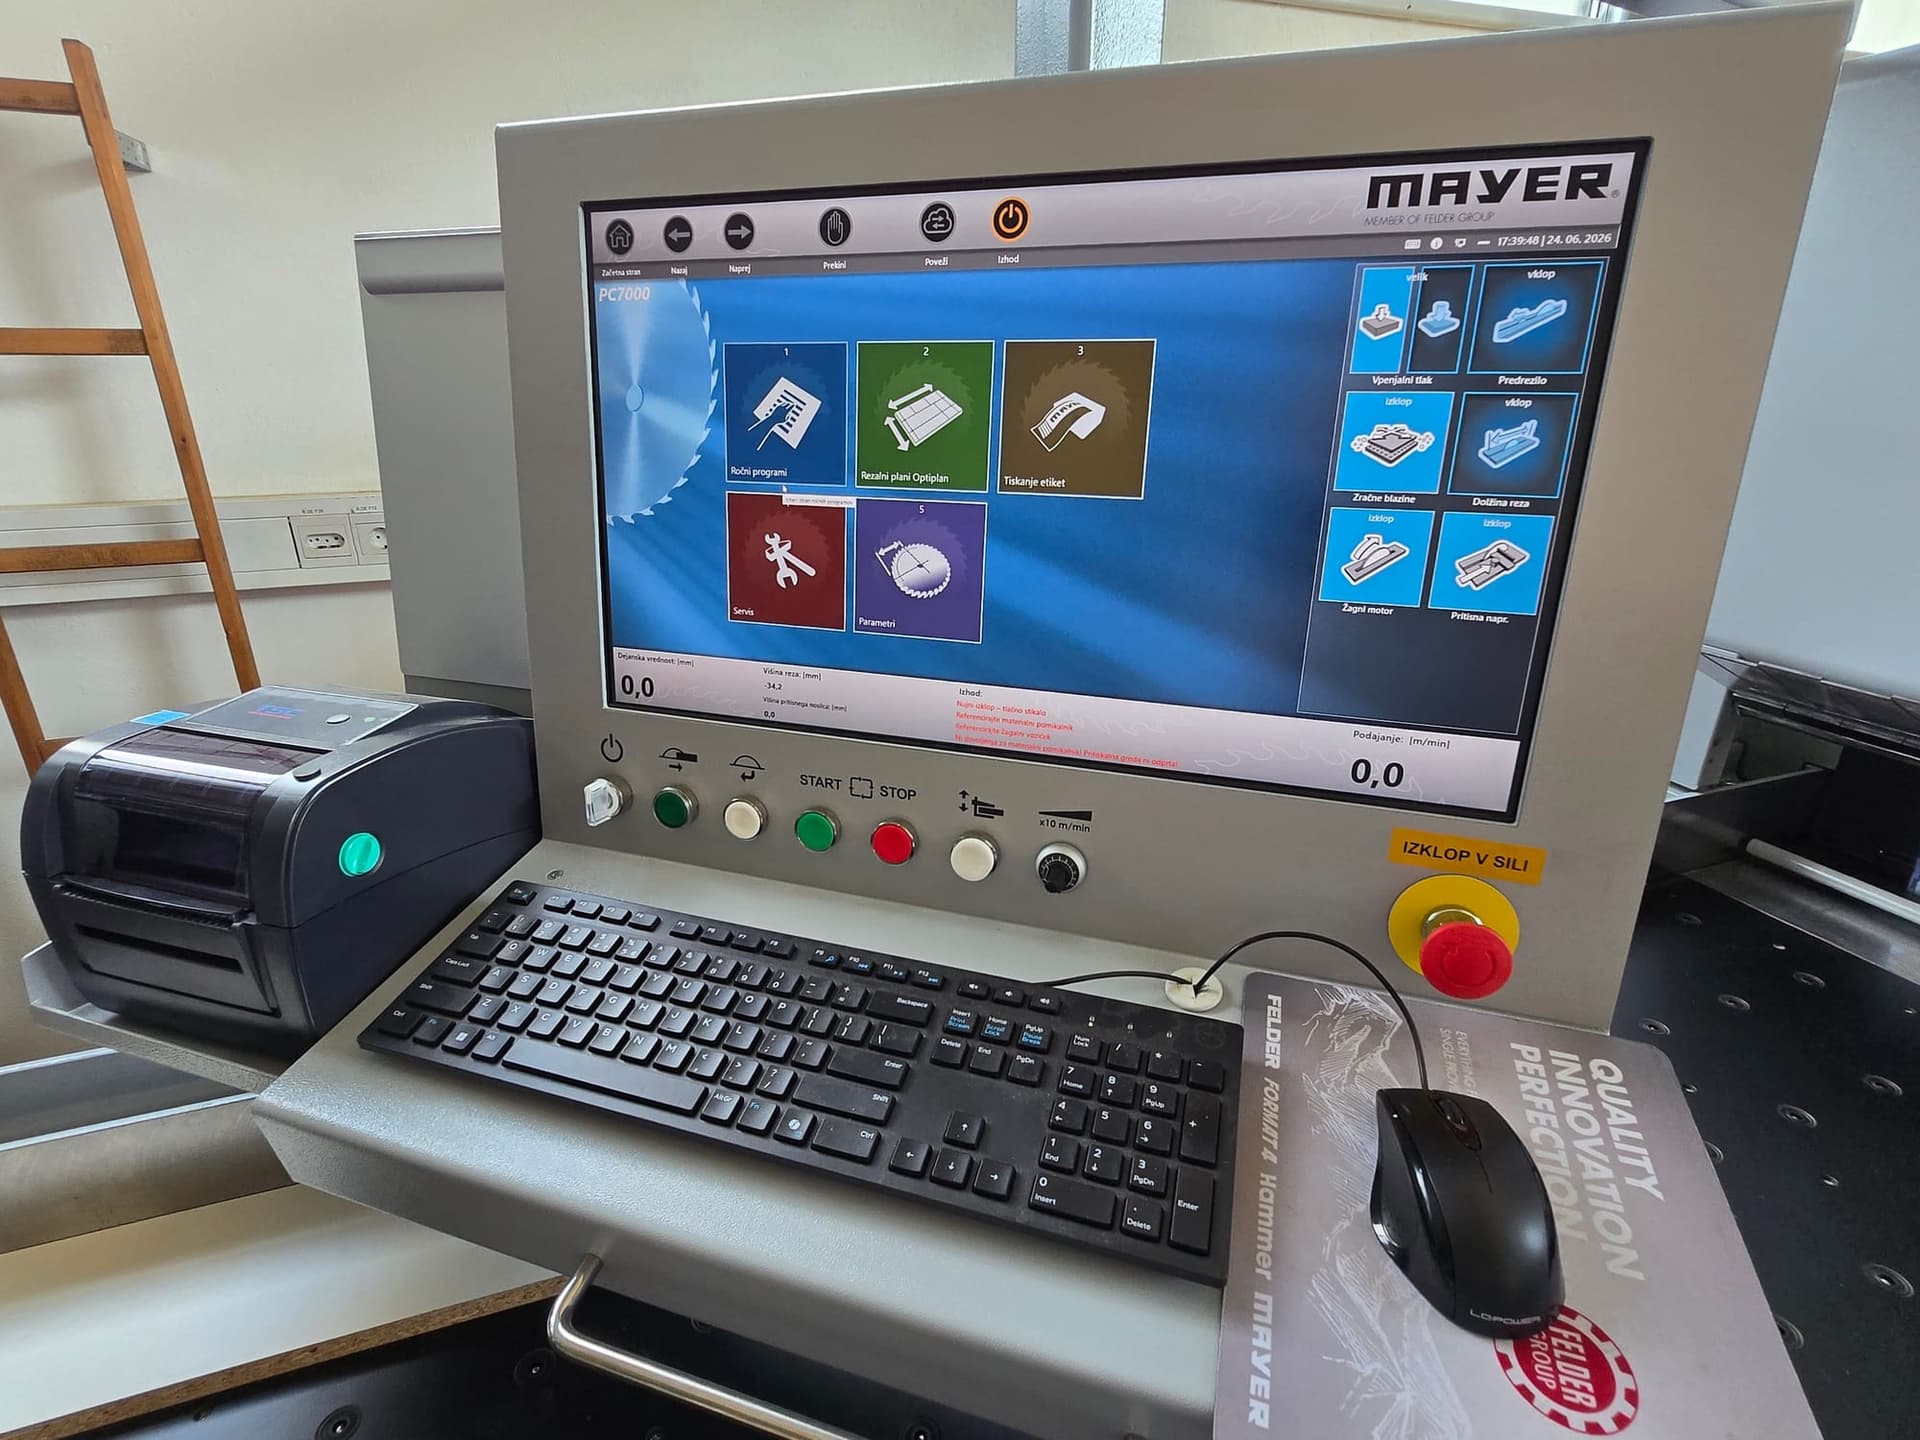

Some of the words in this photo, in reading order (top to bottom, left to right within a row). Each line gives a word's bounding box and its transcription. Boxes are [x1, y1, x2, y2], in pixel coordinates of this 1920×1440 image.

[1366, 163, 1611, 209] MAYER
[1364, 214, 1404, 226] MEMBER
[1407, 214, 1422, 225] OF
[1424, 213, 1455, 224] FELDER
[1457, 212, 1495, 223] GROUP
[1498, 236, 1539, 247] 17:39:48
[1584, 233, 1612, 244] 2026
[823, 260, 847, 270] Prekini
[997, 254, 1020, 265] Izhod
[625, 268, 641, 277] stran
[671, 266, 688, 276] Nazaj
[728, 263, 751, 275] Naprej
[1527, 269, 1556, 280] vklop
[1406, 271, 1429, 282] velik
[599, 286, 650, 302] PC7000
[1372, 375, 1414, 386] Vpenjalni
[1415, 375, 1433, 385] tlak
[1498, 375, 1548, 385] Predrezilo
[1385, 397, 1412, 408] izklop
[1505, 398, 1532, 409] vklop
[730, 467, 751, 477] Ročni
[751, 468, 787, 479] programi
[861, 470, 888, 481] Rezalni
[889, 472, 911, 483] plani
[912, 472, 950, 485] Optiplan
[1003, 476, 1039, 489] Tiskanje
[1040, 478, 1066, 488] etiket
[1352, 493, 1382, 503] Zračne
[1384, 494, 1416, 504] blazine
[1472, 498, 1504, 508] Dolžina
[1505, 499, 1530, 508] reza
[1368, 514, 1394, 524] izklop
[1483, 519, 1511, 529] izklop
[733, 606, 754, 616] Servis
[1342, 603, 1367, 616] Žagni
[1369, 606, 1394, 616] motor
[858, 617, 896, 629] Parametri
[1451, 612, 1484, 623] Pritisna
[1486, 614, 1509, 624] napr.
[621, 674, 654, 699] 0,0
[959, 688, 983, 698] Izhod:
[764, 710, 776, 719] 0,0
[1353, 730, 1404, 744] Podajanje:
[1409, 736, 1450, 749] [m/min]
[1351, 758, 1404, 789] 0,0
[800, 774, 842, 790] START
[880, 785, 917, 800] STOP
[1039, 819, 1056, 828] x10
[1058, 822, 1091, 832] m/min
[1402, 841, 1470, 862] IZKLOP
[1476, 852, 1488, 865] V
[1492, 856, 1529, 872] SILI
[703, 1018, 712, 1027] K
[602, 1028, 611, 1036] B
[1264, 993, 1282, 1070] FELDER
[633, 1036, 643, 1045] N
[666, 1044, 676, 1053] M
[884, 1060, 903, 1069] Enter
[1107, 1075, 1116, 1084] 8
[1149, 1085, 1158, 1094] 9
[872, 1093, 889, 1102] Shift
[1058, 1101, 1067, 1110] 4
[1101, 1111, 1110, 1120] 5
[1143, 1120, 1152, 1130] 6
[1588, 1057, 1665, 1202] QUALITY
[860, 1130, 875, 1140] Ctrl
[1509, 1041, 1589, 1242] PERFECTION
[1045, 1152, 1059, 1162] End
[1093, 1148, 1102, 1158] 2
[1137, 1160, 1146, 1169] 3
[1548, 1048, 1646, 1281] INNOVATION
[1039, 1177, 1048, 1186] 0
[1177, 1200, 1200, 1211] Enter
[1127, 1217, 1152, 1231] Delete
[1254, 1173, 1278, 1281] Hammer
[1248, 1292, 1273, 1430] MAYER
[1548, 1326, 1598, 1409] FELDER
